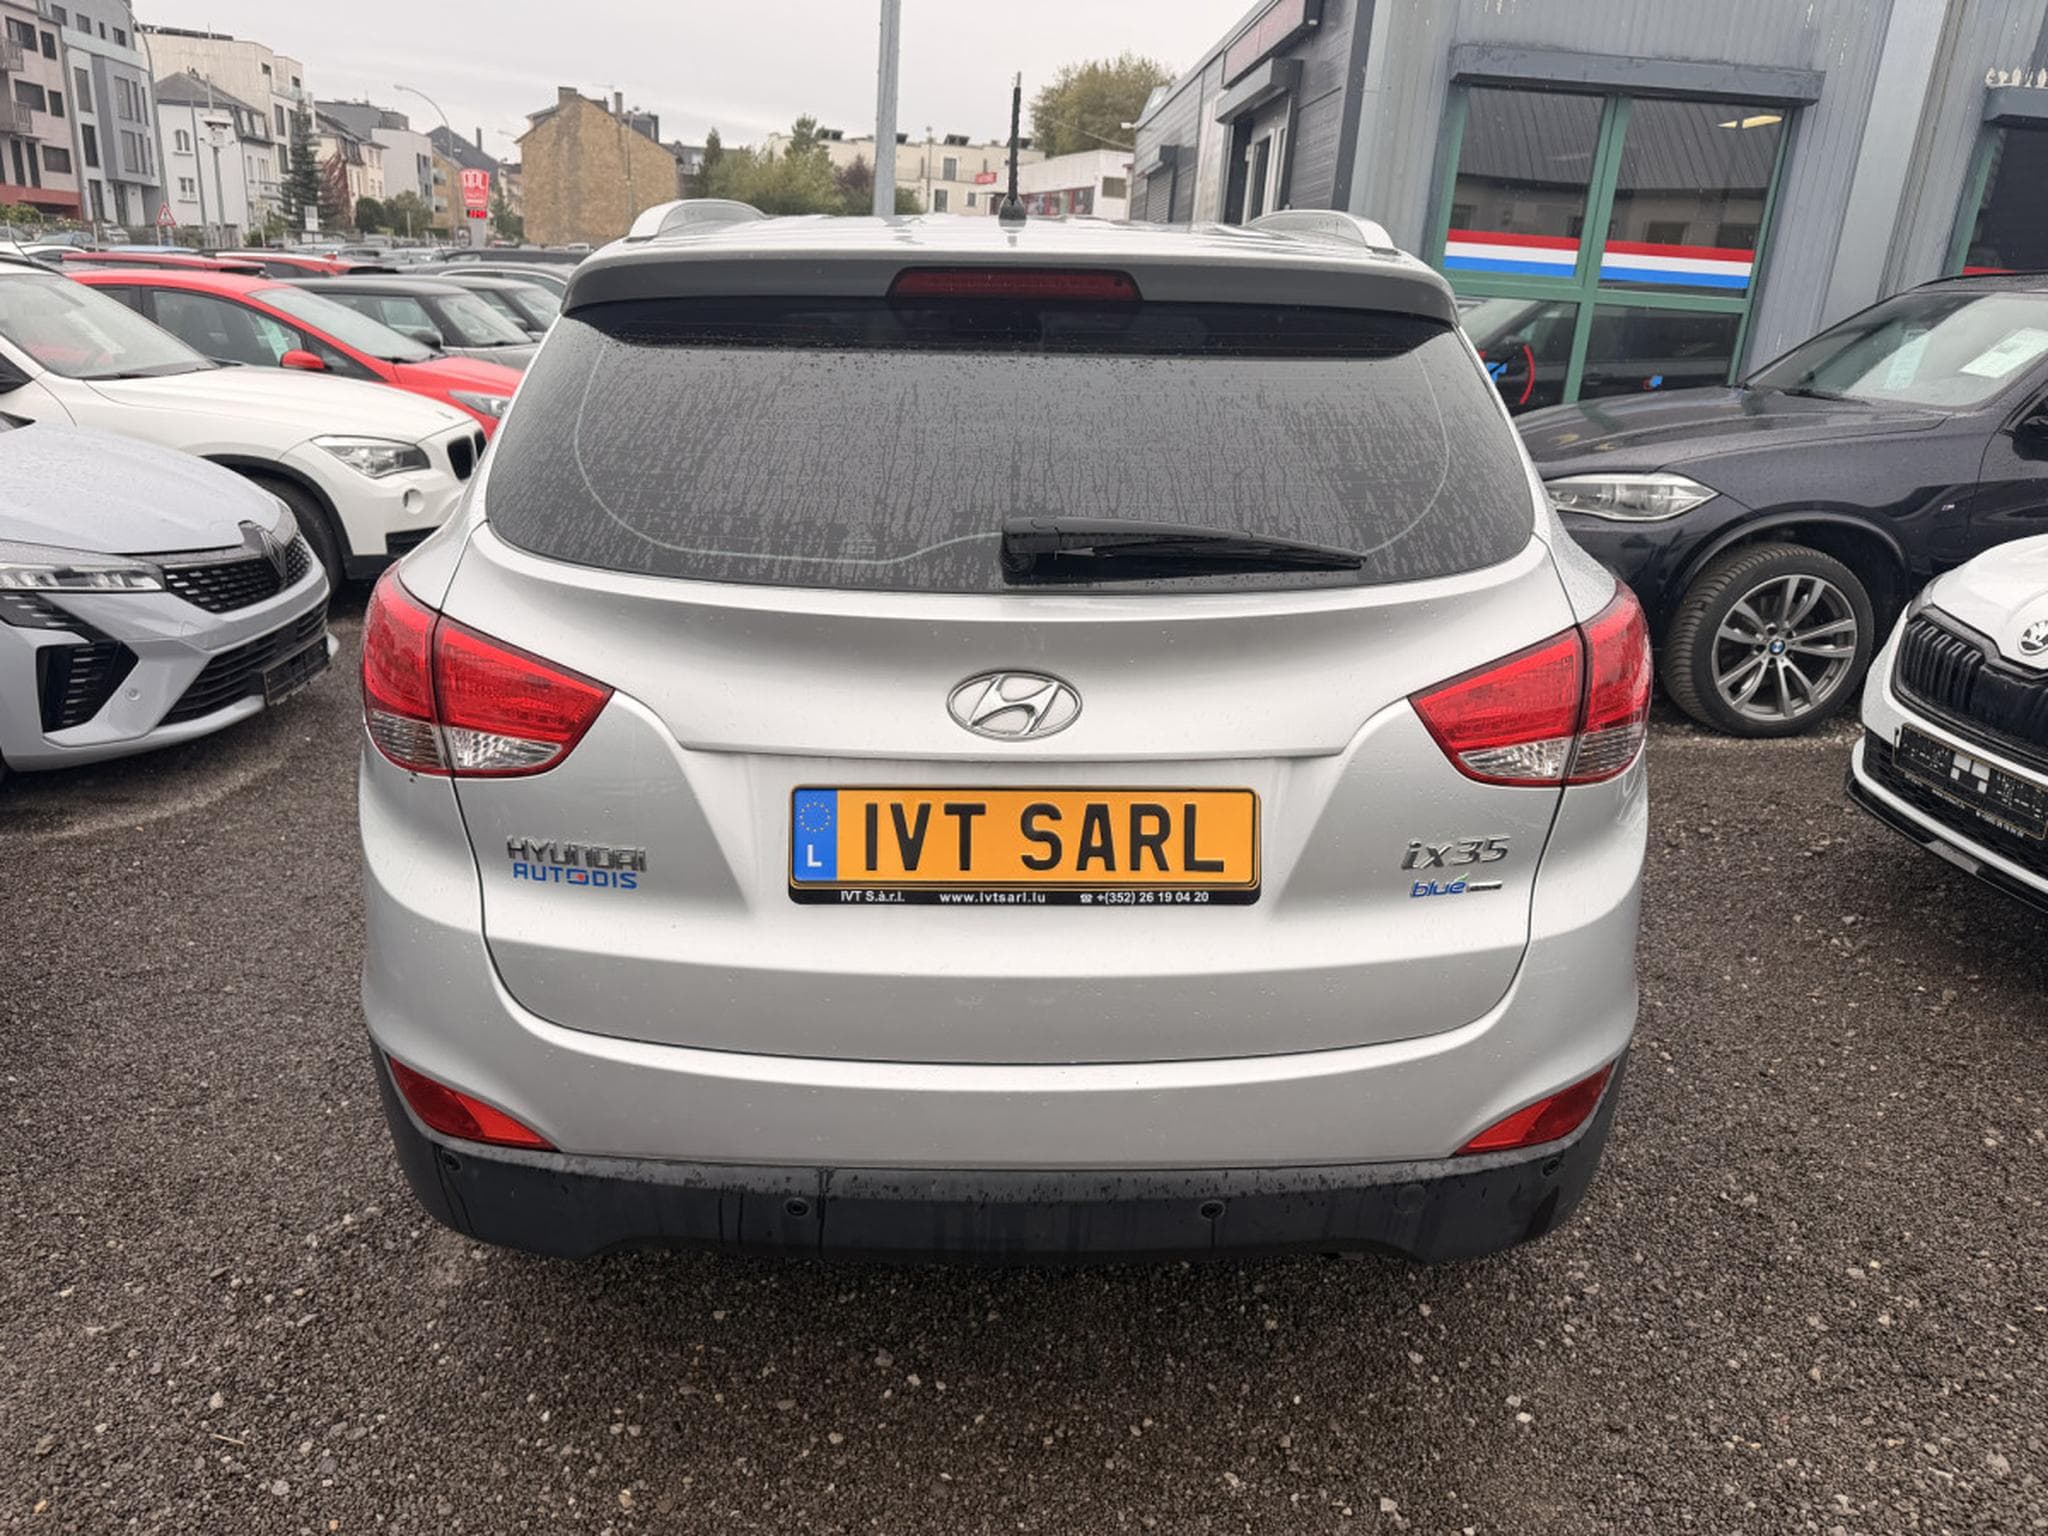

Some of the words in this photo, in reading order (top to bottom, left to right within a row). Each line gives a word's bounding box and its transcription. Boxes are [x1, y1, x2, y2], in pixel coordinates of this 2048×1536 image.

[865, 802, 986, 872] IVT
[1019, 802, 1226, 873] SARL
[506, 835, 648, 872] HYUNDAI
[807, 844, 822, 867] L
[1401, 835, 1511, 870] ix35
[512, 862, 638, 890] AUTODIS
[1410, 878, 1467, 898] blue
[840, 890, 862, 902] IVT
[939, 891, 1046, 903] www.ivtsarl.lu
[1139, 891, 1155, 902] 26
[1158, 891, 1173, 902] 19
[1175, 891, 1191, 902] 04
[1194, 891, 1210, 902] 20
